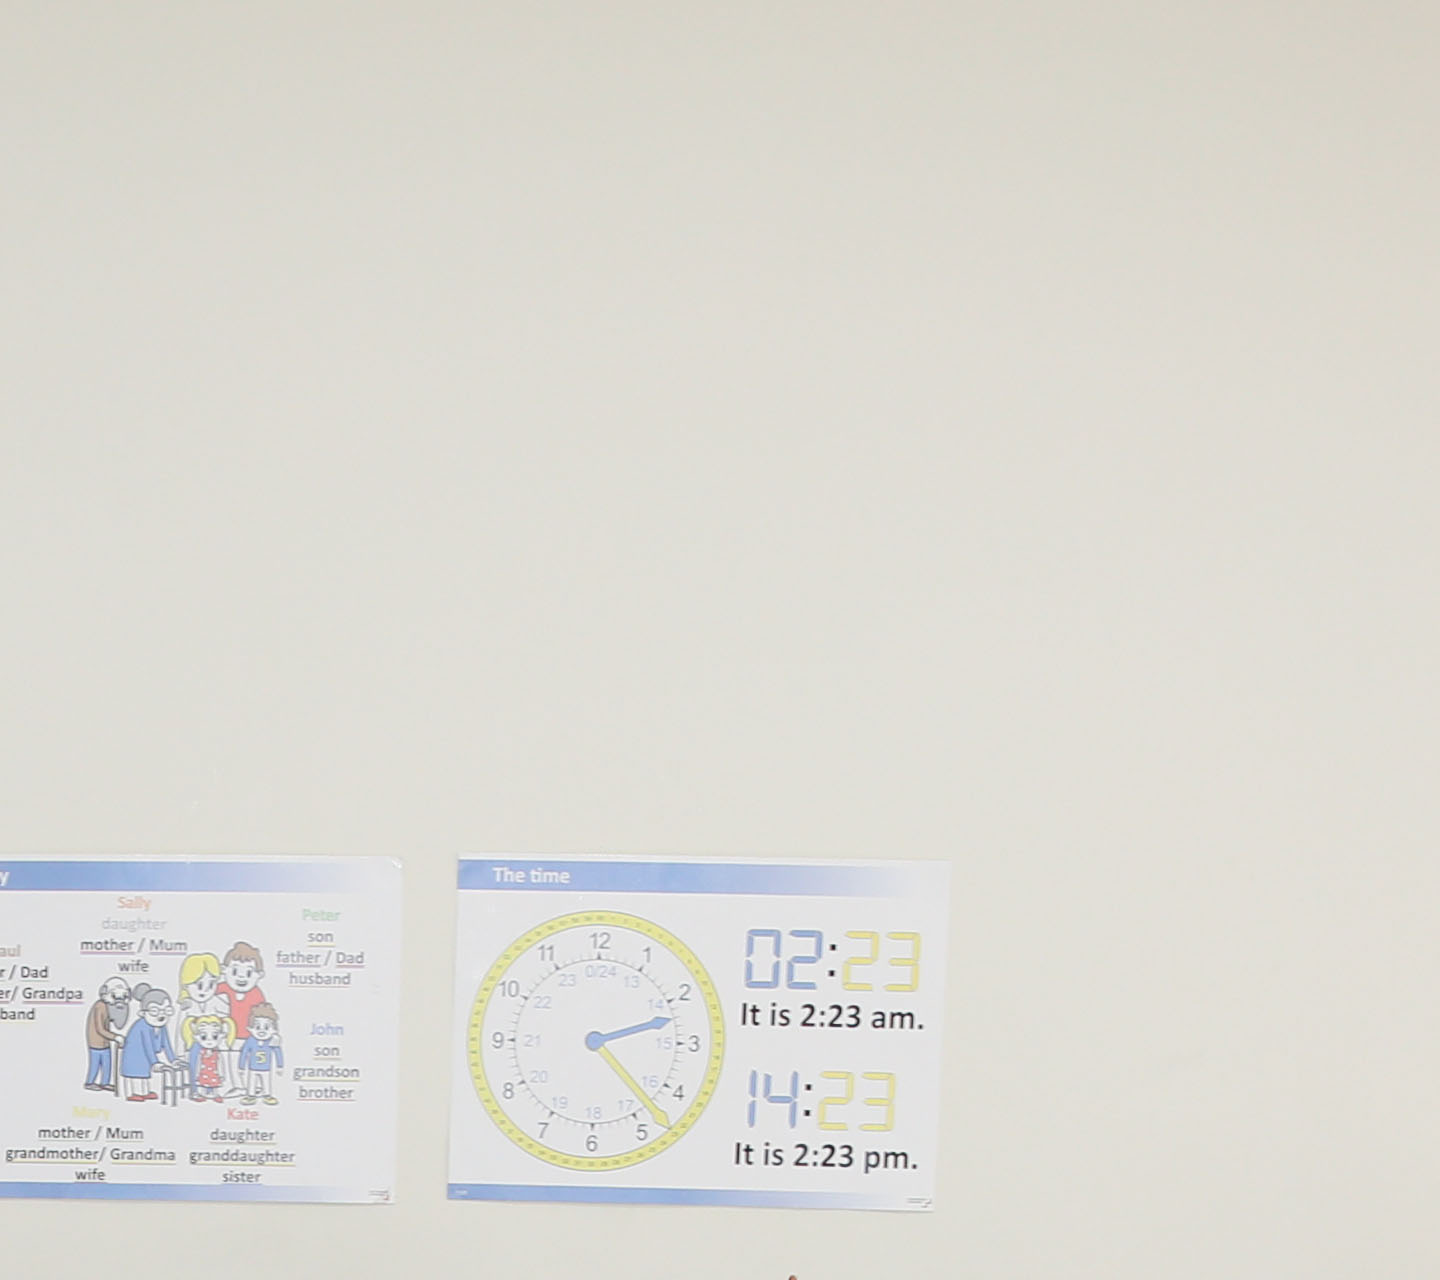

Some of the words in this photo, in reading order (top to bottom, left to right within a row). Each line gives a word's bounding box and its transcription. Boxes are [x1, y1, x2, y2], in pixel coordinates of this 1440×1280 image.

[492, 867, 526, 884] The
[530, 867, 570, 884] time
[117, 897, 152, 911] Sally
[302, 908, 341, 921] Peter
[102, 917, 167, 932] daughter
[307, 931, 334, 943] son
[589, 932, 611, 949] 12
[80, 938, 135, 952] mother
[149, 939, 187, 952] Mum
[538, 944, 555, 961] 11
[276, 951, 321, 964] father
[336, 951, 364, 964] Dad
[642, 947, 651, 963] 1
[744, 929, 922, 992] 02:23
[21, 966, 49, 979] Dad
[118, 959, 150, 973] wife
[289, 972, 351, 985] husband
[22, 987, 83, 1002] Grandpa
[499, 980, 519, 998] 10
[679, 983, 691, 1001] 2
[741, 1003, 760, 1026] It
[769, 1003, 790, 1027] is
[800, 1004, 861, 1029] 2:23
[871, 1008, 924, 1030] am.
[310, 1023, 344, 1036] John
[491, 1031, 504, 1049] 9
[688, 1035, 700, 1052] 3
[313, 1046, 340, 1057] son
[293, 1066, 360, 1080] grandson
[299, 1086, 354, 1099] brother
[503, 1082, 514, 1099] 8
[672, 1084, 684, 1101] 4
[747, 1070, 896, 1132] 14:23
[227, 1108, 259, 1121] Kate
[38, 1126, 91, 1140] mother
[105, 1128, 144, 1140] Mum
[210, 1129, 276, 1144] daughter
[538, 1122, 549, 1138] 7
[636, 1124, 648, 1141] 5
[586, 1135, 598, 1152] 6
[110, 1147, 176, 1161] Grandma
[189, 1150, 296, 1164] granddaughter
[735, 1142, 754, 1165] It
[763, 1142, 784, 1167] is
[793, 1143, 854, 1168] 2:23
[864, 1150, 918, 1174] pm.
[75, 1168, 105, 1181] wife
[222, 1170, 261, 1183] sister
